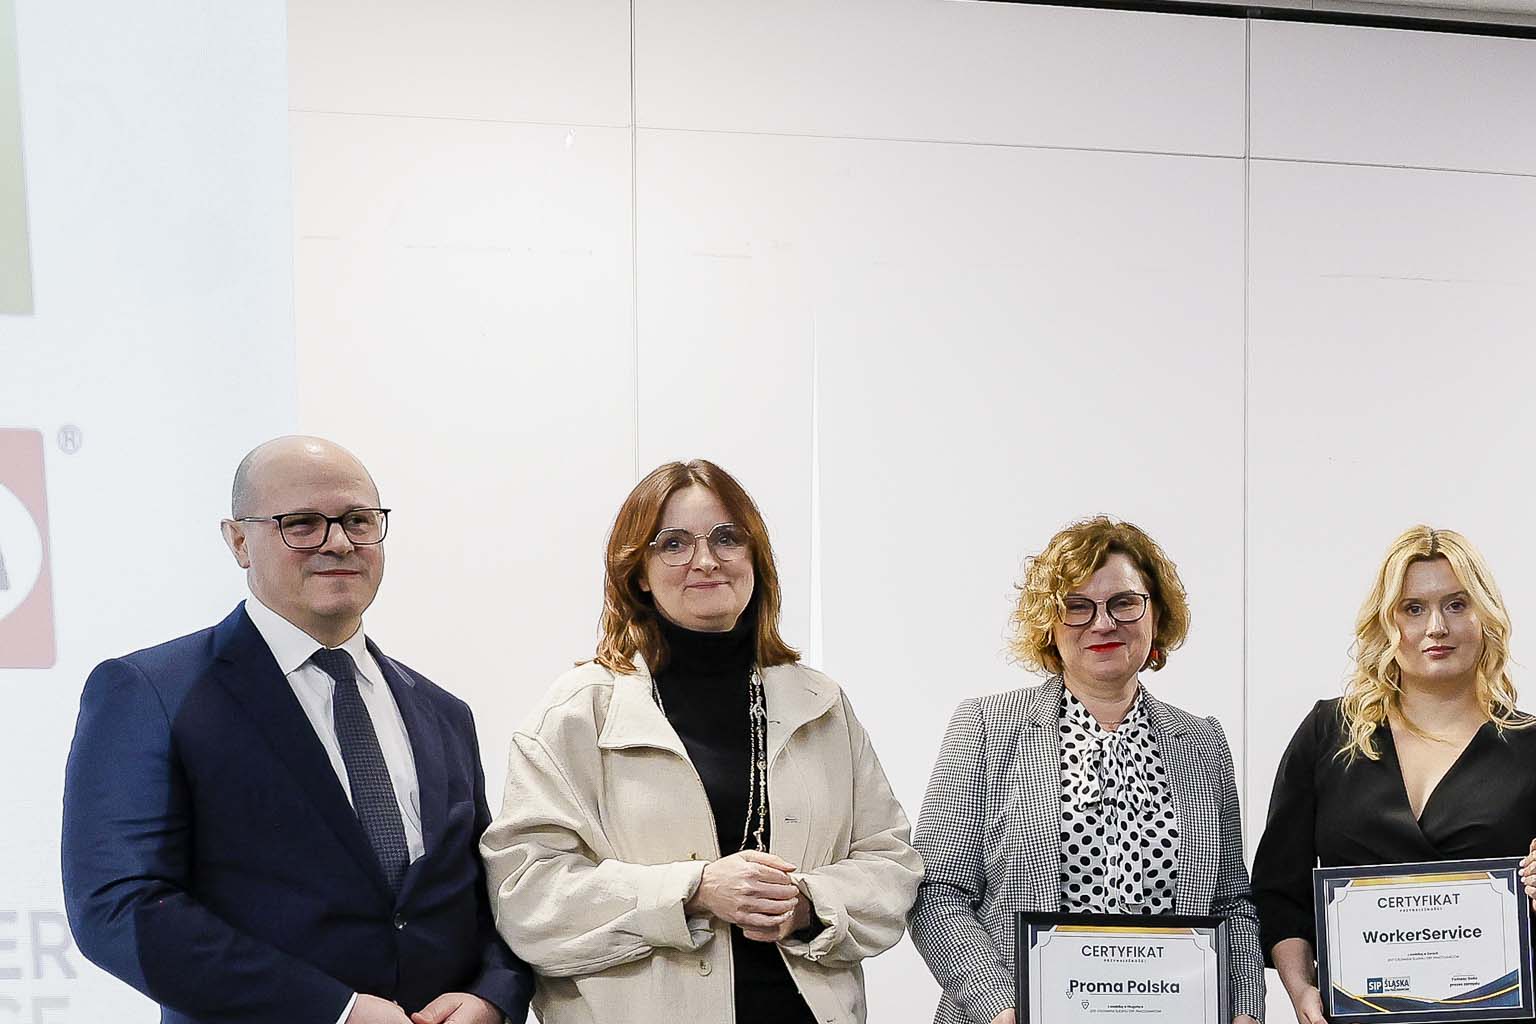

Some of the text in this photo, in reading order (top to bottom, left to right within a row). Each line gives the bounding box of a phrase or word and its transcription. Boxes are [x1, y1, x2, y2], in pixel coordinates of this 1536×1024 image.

[1377, 893, 1461, 909] CERTYFIKAT
[1362, 925, 1482, 944] WorkerService
[1081, 945, 1164, 959] CERTYFIKAT
[1069, 979, 1180, 994] Proma Polska
[1368, 980, 1382, 992] SIP
